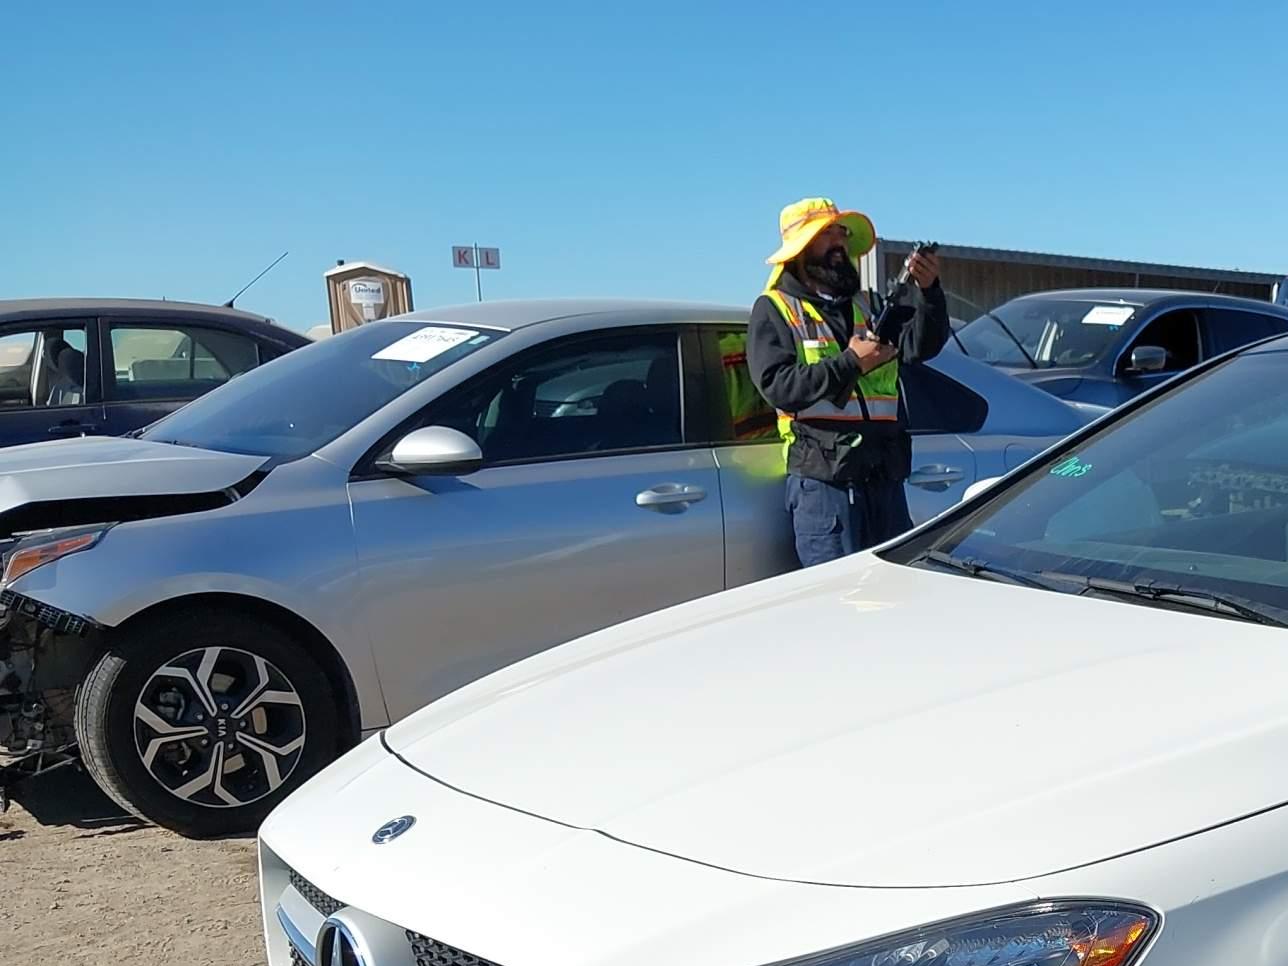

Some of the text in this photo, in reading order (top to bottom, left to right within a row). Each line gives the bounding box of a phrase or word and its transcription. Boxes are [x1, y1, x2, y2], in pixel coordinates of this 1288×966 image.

[457, 249, 497, 266] K L
[217, 718, 227, 737] KIA
